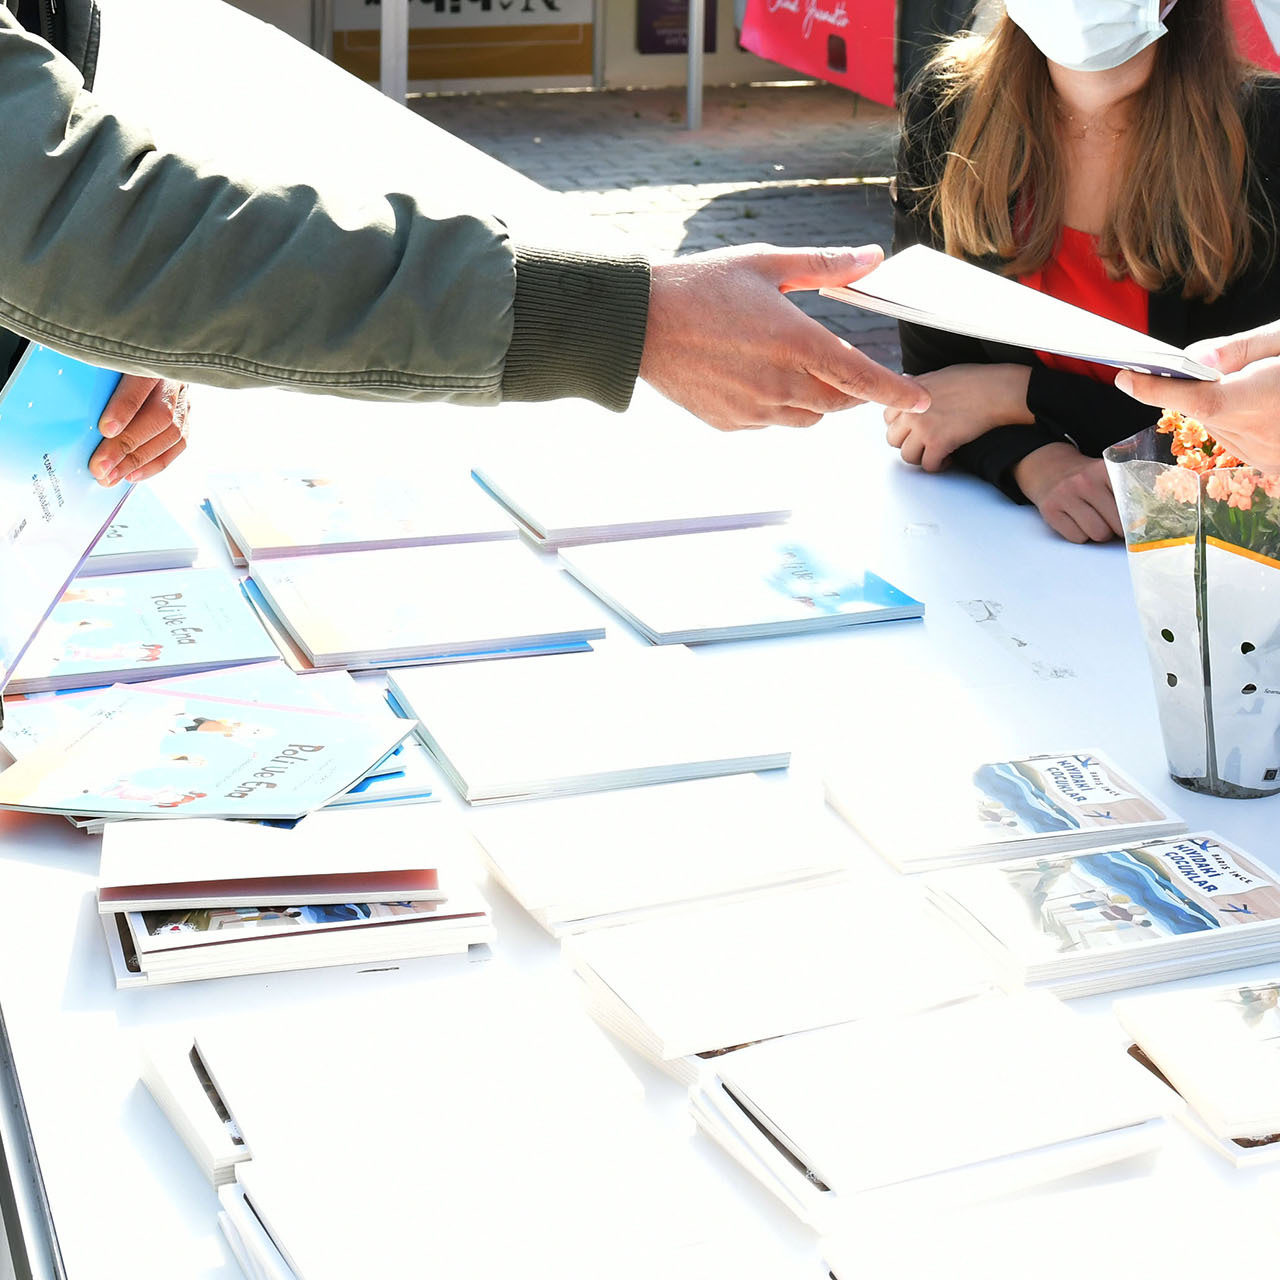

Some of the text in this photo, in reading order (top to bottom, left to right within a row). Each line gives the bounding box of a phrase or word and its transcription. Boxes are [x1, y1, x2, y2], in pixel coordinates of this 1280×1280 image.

[224, 781, 277, 798] Ena
[1163, 851, 1218, 892] ÇOCUKLAR
[1173, 844, 1224, 878] KIYIDAKİ
